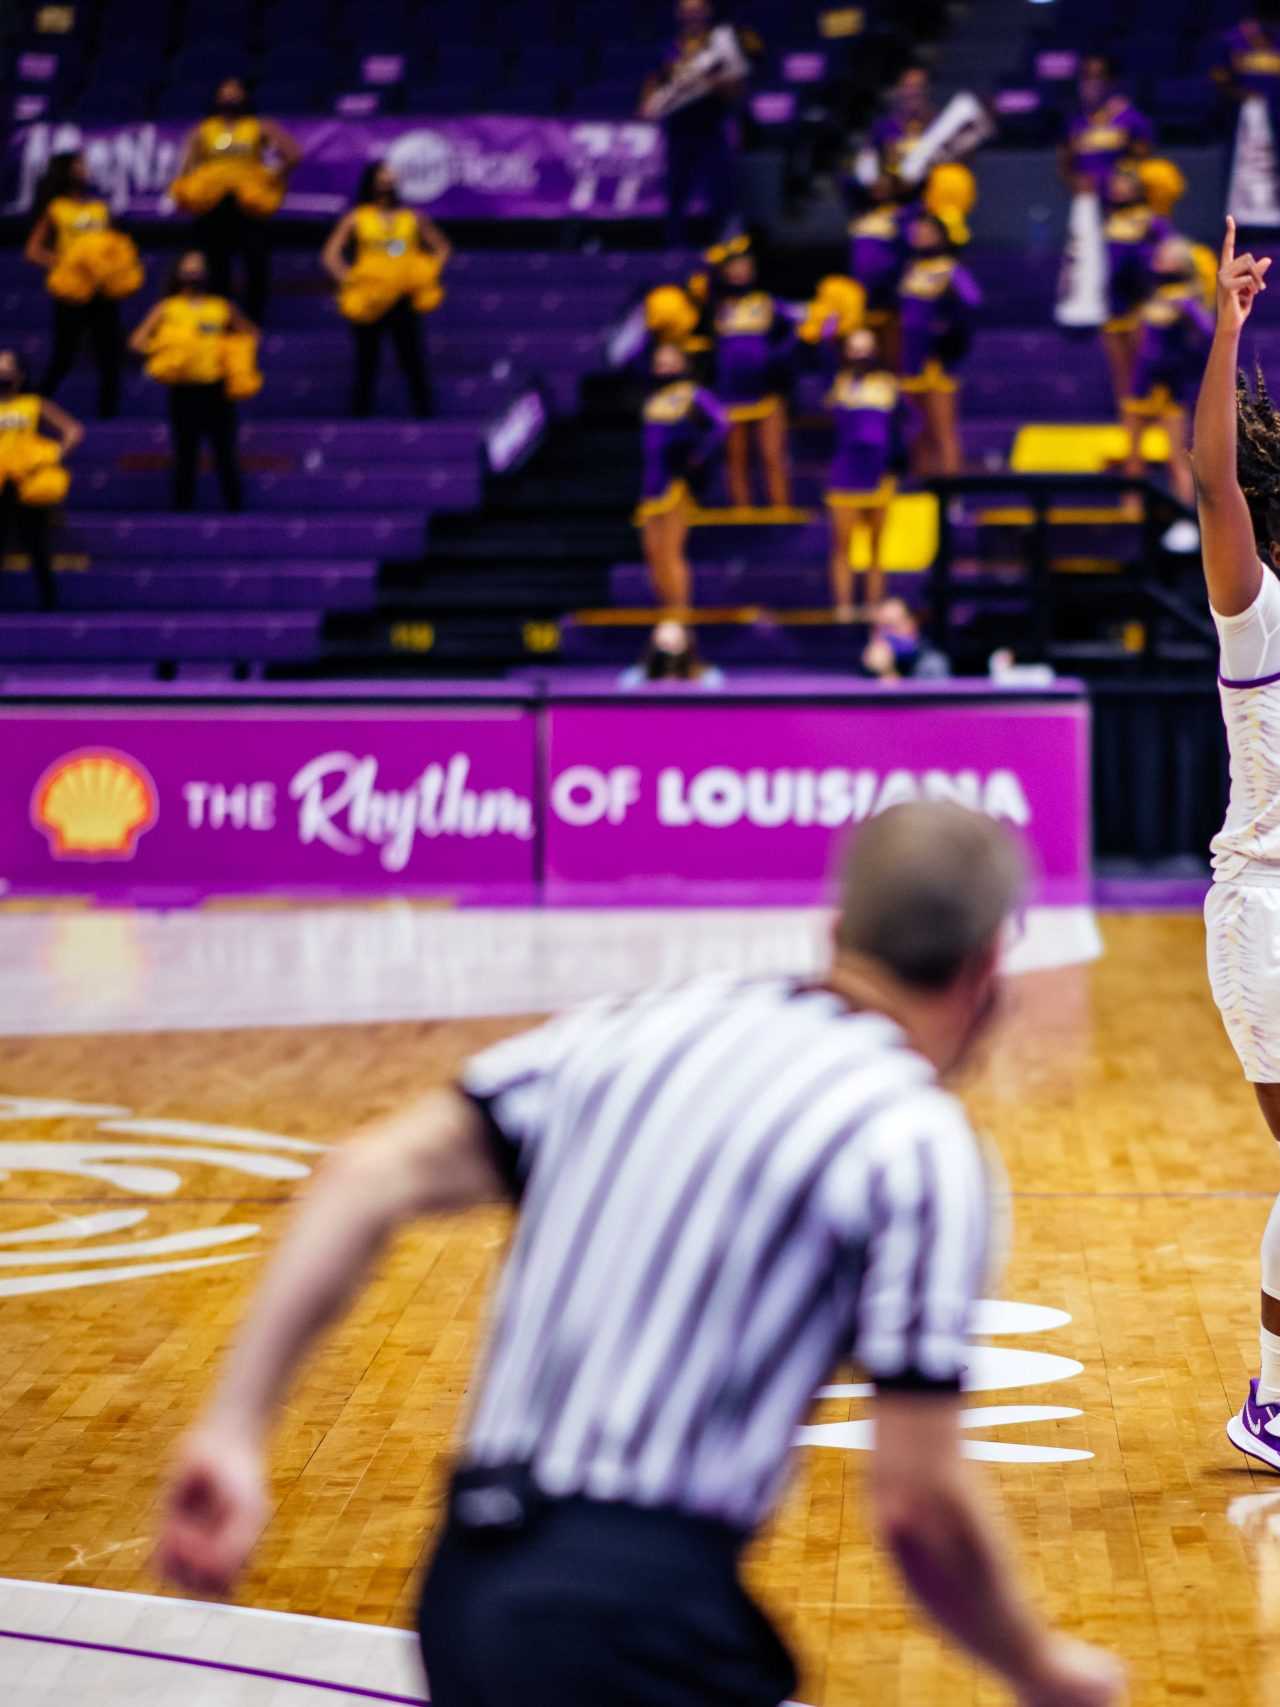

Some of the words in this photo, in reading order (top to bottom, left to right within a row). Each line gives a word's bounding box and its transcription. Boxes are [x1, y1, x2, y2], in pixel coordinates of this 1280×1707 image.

[182, 780, 278, 831] THE
[288, 750, 536, 872] Rhythm
[551, 764, 641, 827] OF
